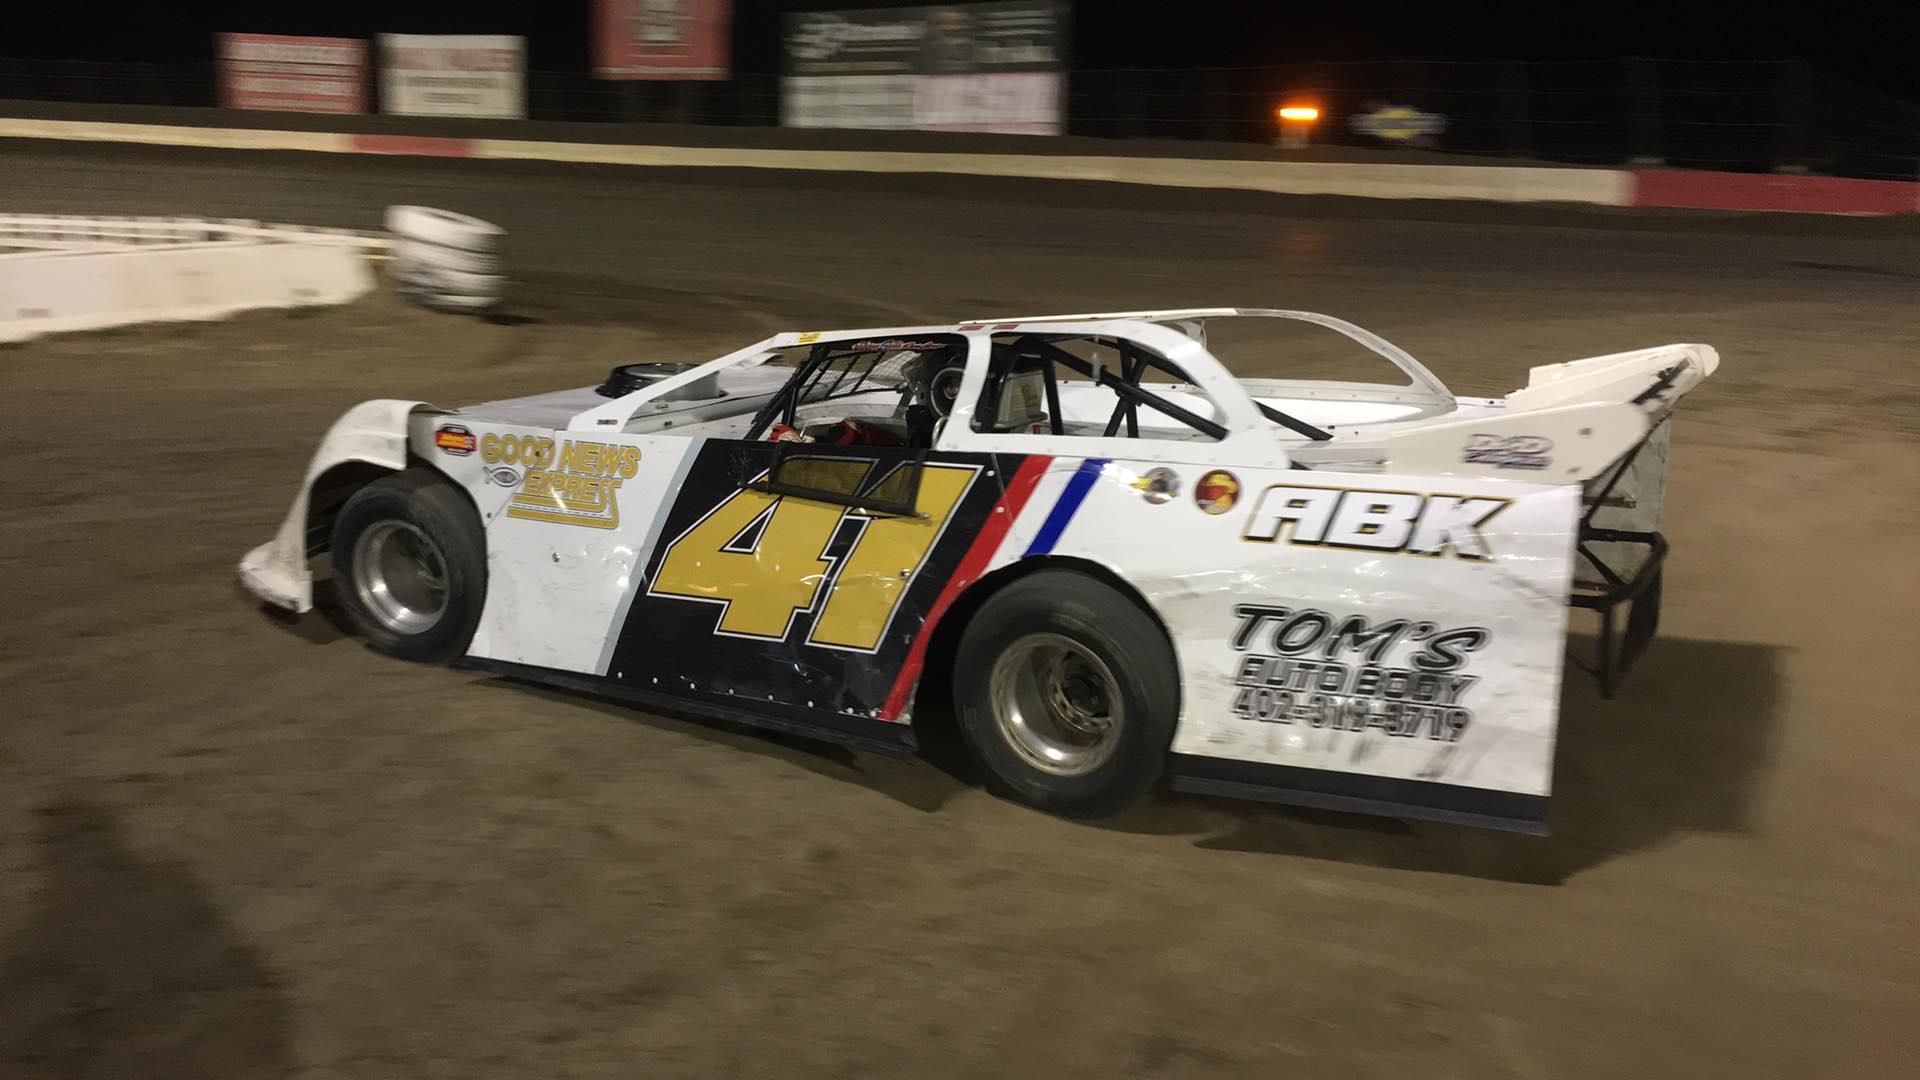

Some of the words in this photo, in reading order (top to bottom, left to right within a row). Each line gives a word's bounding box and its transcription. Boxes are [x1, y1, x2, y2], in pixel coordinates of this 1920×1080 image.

[480, 432, 556, 469] GOOD
[558, 439, 641, 479] NEWS
[510, 468, 623, 514] EXPRESS
[1241, 484, 1517, 563] ABK
[647, 456, 984, 655] 41
[1231, 603, 1492, 672] TOM'S
[1234, 653, 1348, 695] AUTO
[1351, 664, 1481, 704] BODY
